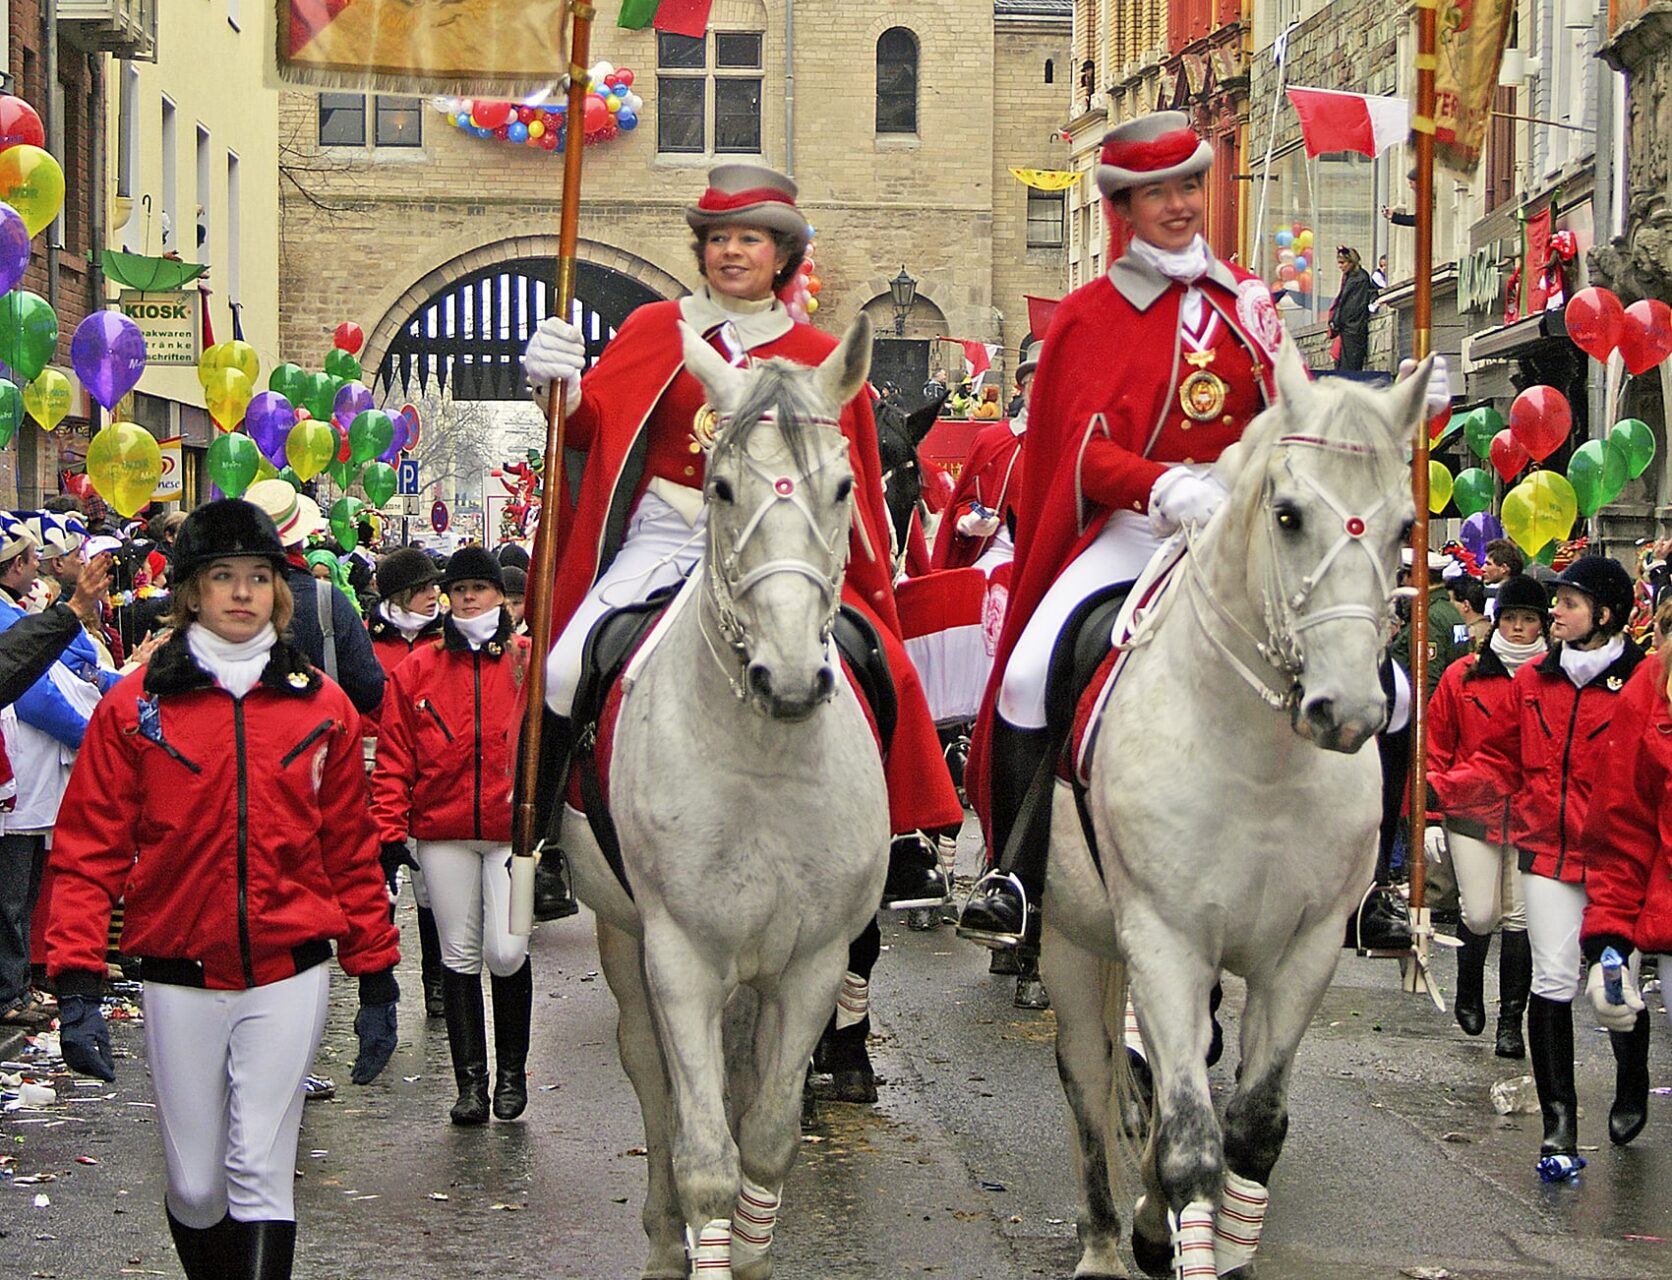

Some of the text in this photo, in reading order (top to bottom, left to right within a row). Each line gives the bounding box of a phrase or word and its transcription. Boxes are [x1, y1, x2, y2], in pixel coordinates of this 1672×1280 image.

[125, 304, 188, 320] KIOSK
[142, 329, 192, 338] akwaren
[145, 340, 192, 349] tränke
[146, 352, 192, 361] schriften
[157, 480, 181, 489] nese
